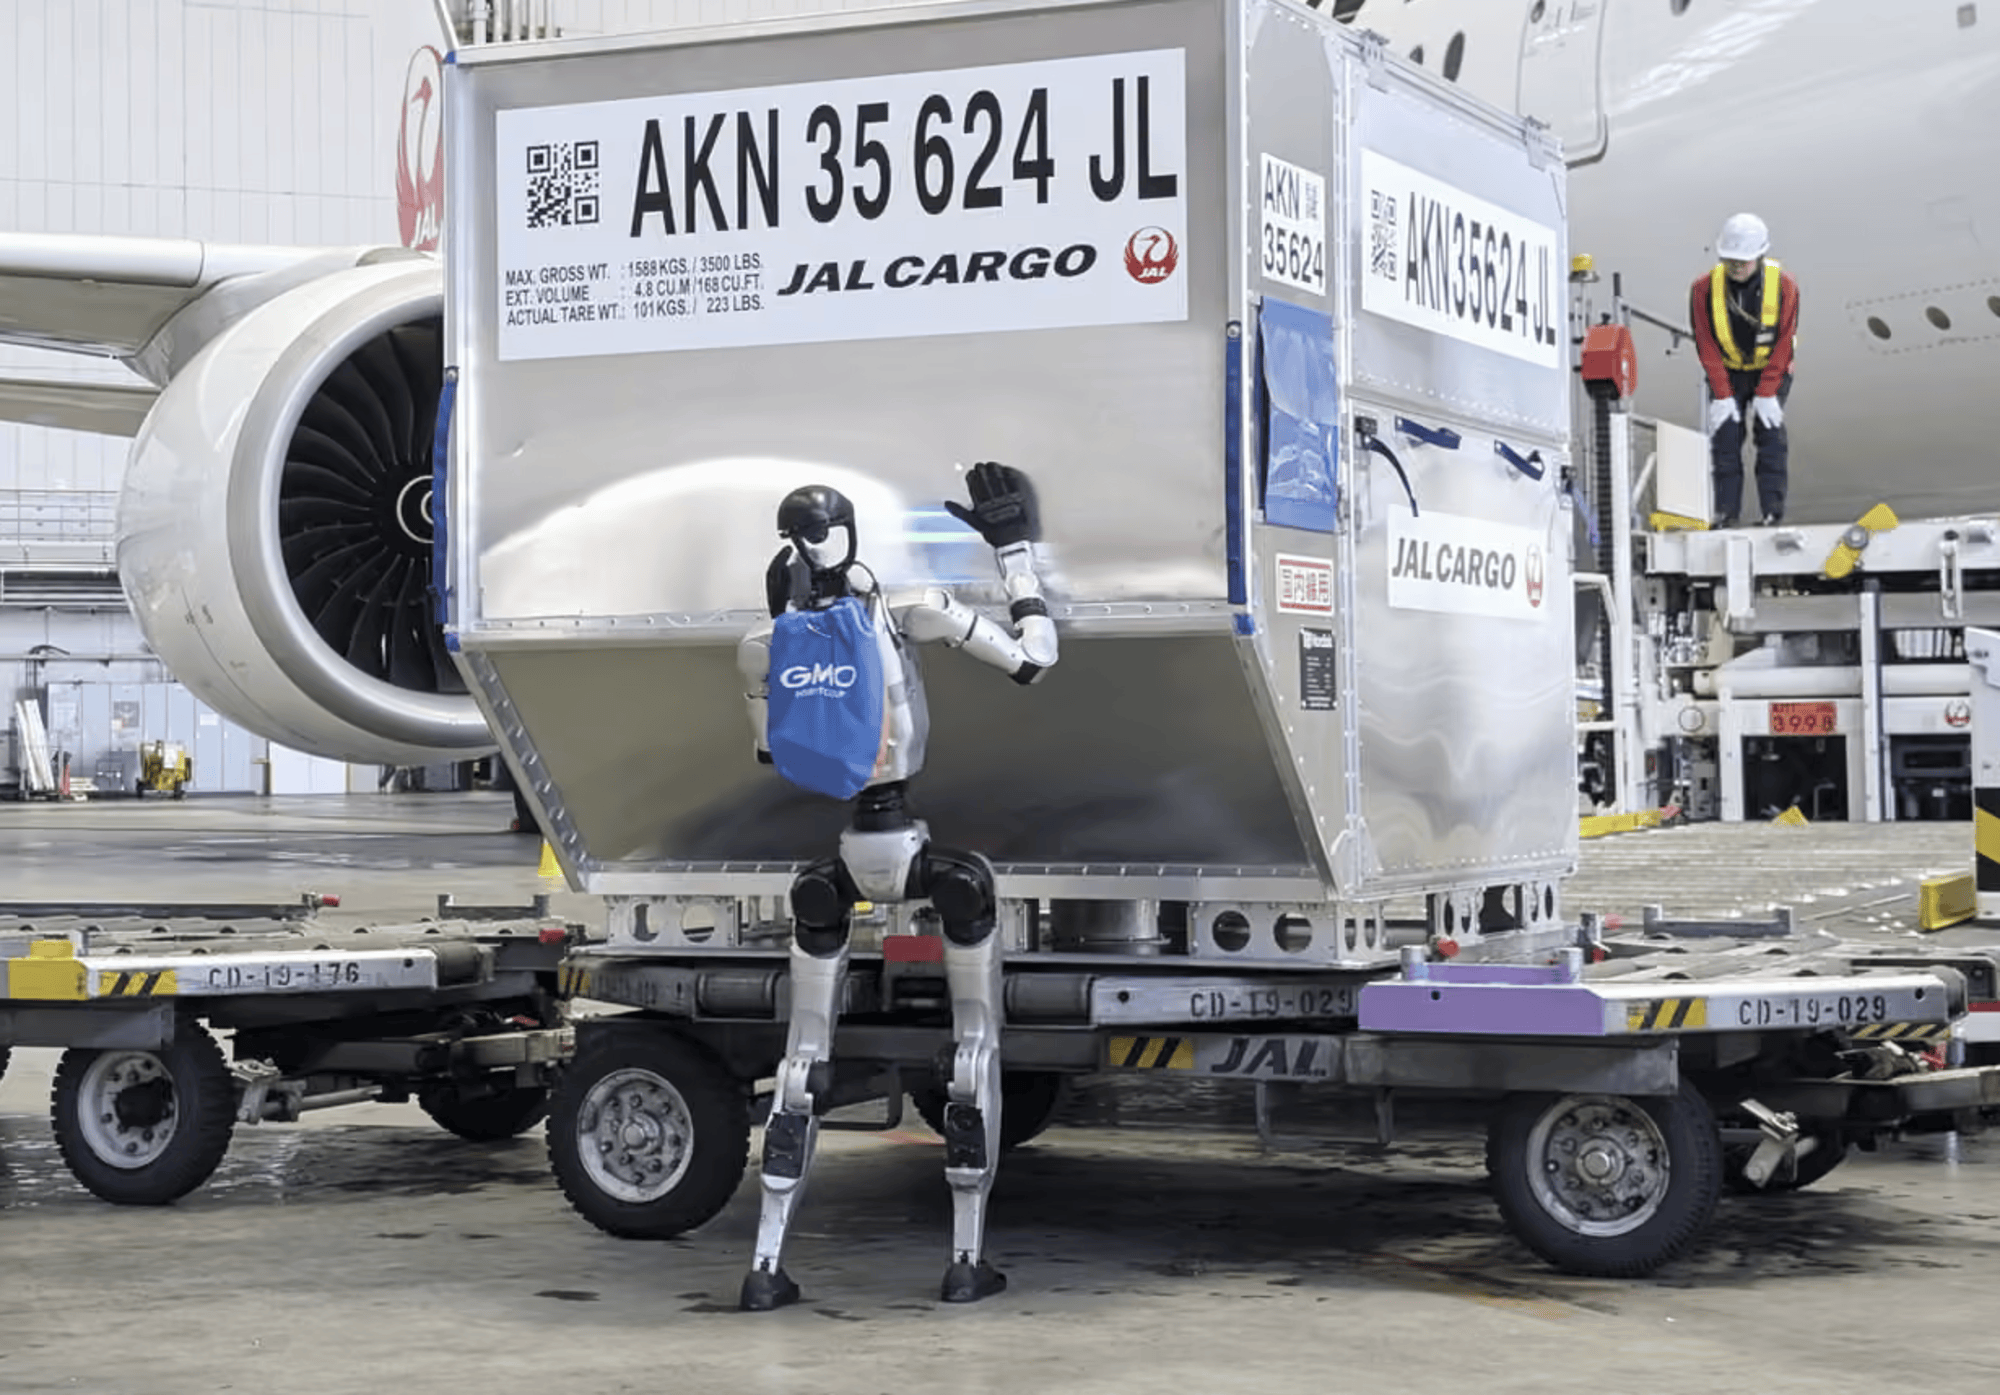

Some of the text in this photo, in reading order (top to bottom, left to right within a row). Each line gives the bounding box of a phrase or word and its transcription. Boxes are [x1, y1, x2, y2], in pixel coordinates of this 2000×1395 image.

[630, 75, 1178, 237] AKN 35 624 JL
[1264, 159, 1300, 220] AKN
[539, 265, 585, 284] GROSS
[587, 262, 610, 281] WT.
[700, 254, 730, 273] 3500
[1264, 222, 1323, 289] 35624
[536, 285, 590, 304] VOLUME
[507, 306, 558, 326] ACTUAL
[560, 303, 595, 322] TARE
[707, 296, 729, 313] 223
[780, 663, 857, 688] GMO
[208, 961, 360, 987] CD-19-176
[1739, 996, 1887, 1026] CD-19-029
[1210, 1036, 1327, 1077] JAL
